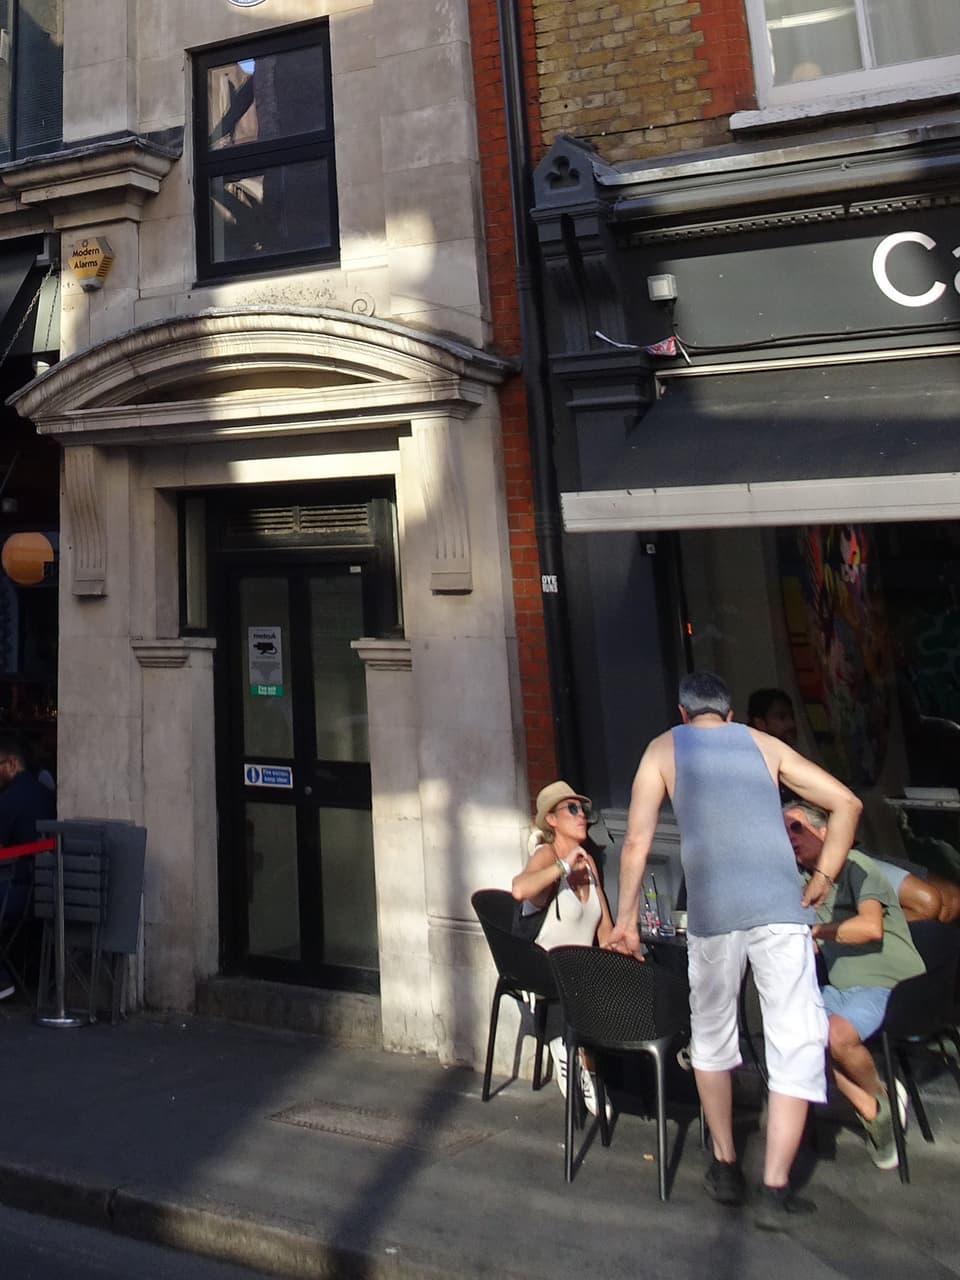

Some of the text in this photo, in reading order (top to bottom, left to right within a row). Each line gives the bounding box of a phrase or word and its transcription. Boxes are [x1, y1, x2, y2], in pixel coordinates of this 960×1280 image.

[72, 247, 100, 257] Modern
[74, 259, 98, 269] Alarms
[872, 230, 960, 306] C
